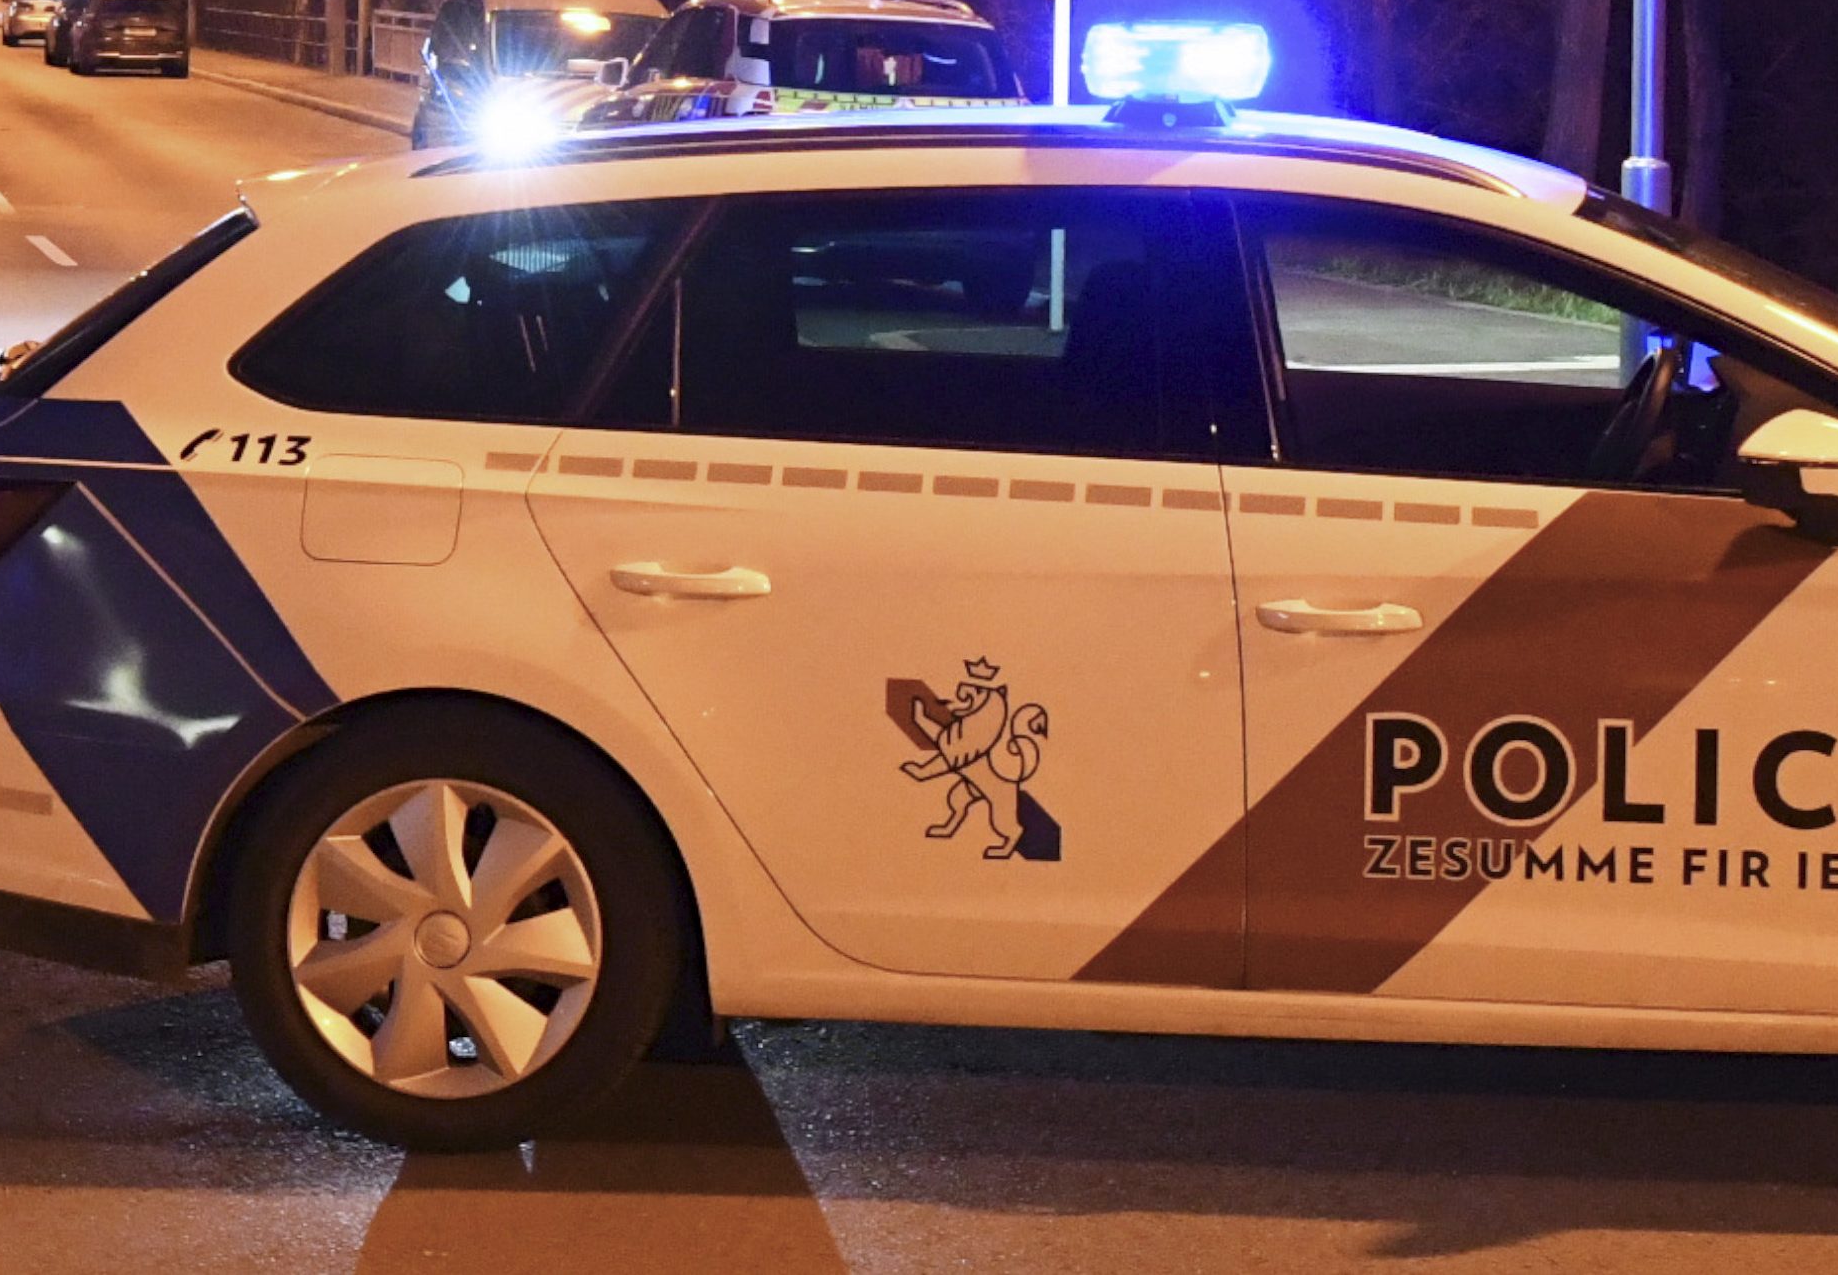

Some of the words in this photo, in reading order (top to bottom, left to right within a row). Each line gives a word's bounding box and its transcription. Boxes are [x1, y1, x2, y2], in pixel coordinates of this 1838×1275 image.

[229, 433, 312, 466] 113
[1363, 835, 1654, 883] ZESUMME
[1681, 847, 1771, 889] FIR
